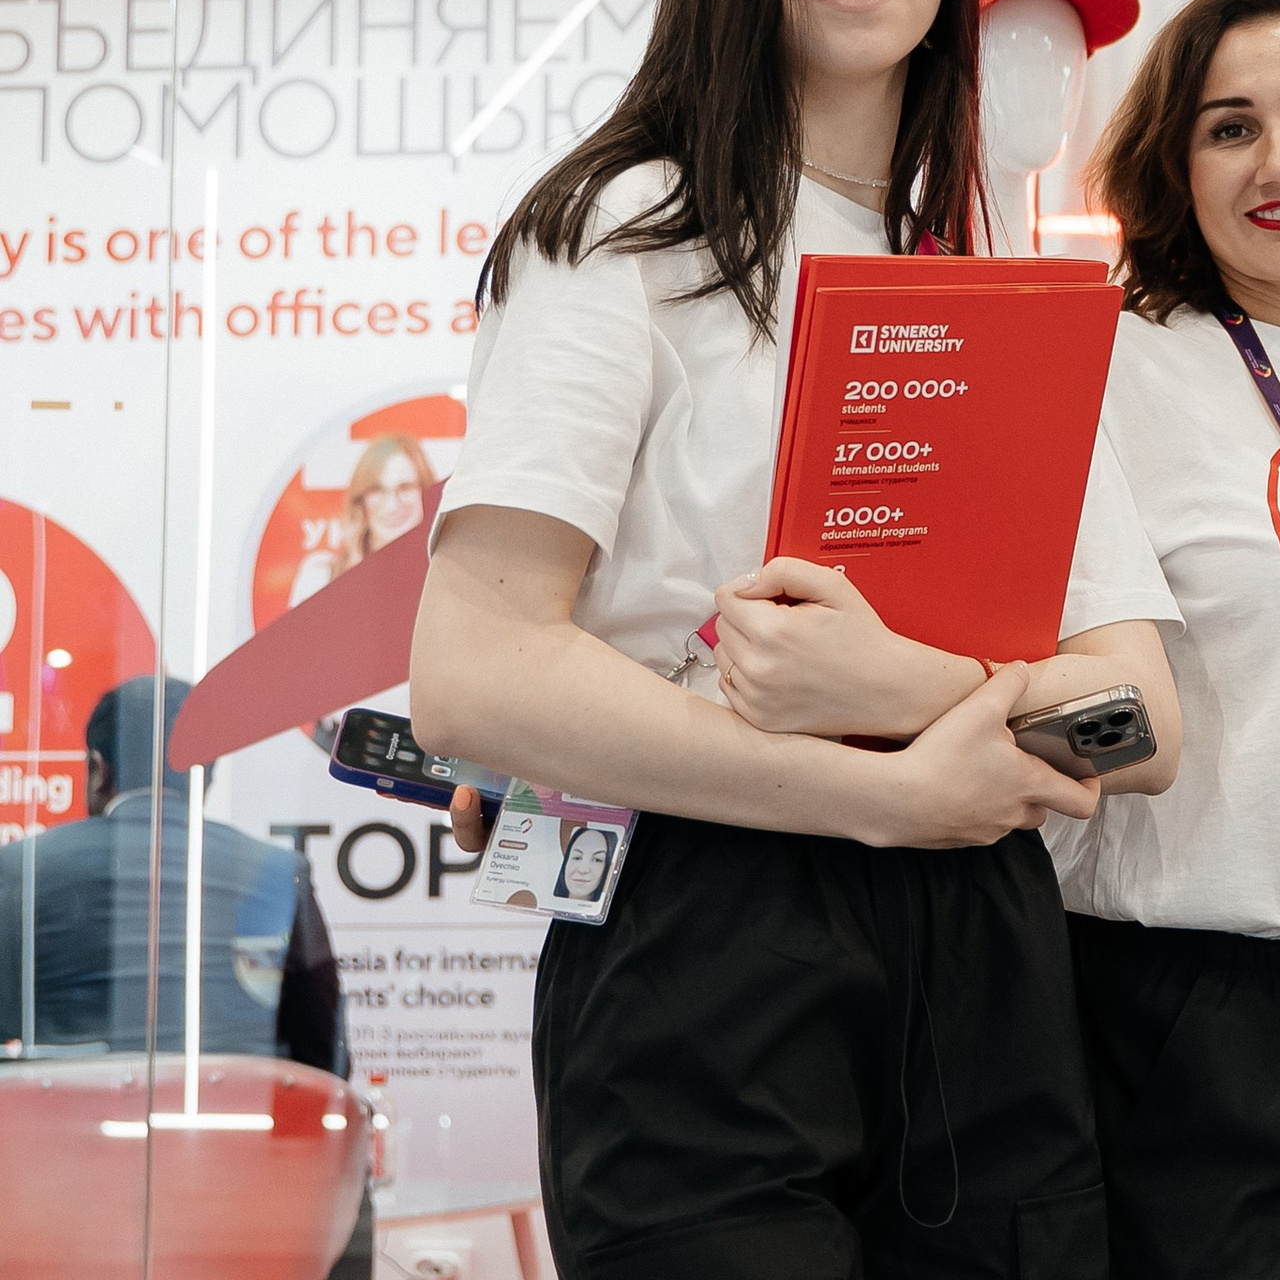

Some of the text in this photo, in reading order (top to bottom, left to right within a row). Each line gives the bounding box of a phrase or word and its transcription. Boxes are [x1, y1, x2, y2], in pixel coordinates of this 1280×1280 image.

[47, 216, 87, 263] is
[106, 227, 219, 262] one
[239, 210, 300, 259] of
[317, 209, 417, 258] the
[74, 290, 203, 341] with
[226, 287, 431, 337] offices
[880, 325, 949, 338] SYNERGY
[878, 339, 964, 353] UNIVERSITY
[844, 379, 969, 400] 200 000+
[841, 403, 887, 414] students
[834, 441, 933, 462] 17 000+
[832, 462, 940, 476] international students
[823, 505, 904, 527] 1000+
[821, 526, 929, 540] educational programs
[396, 946, 432, 971] for
[402, 982, 496, 1009] choice
